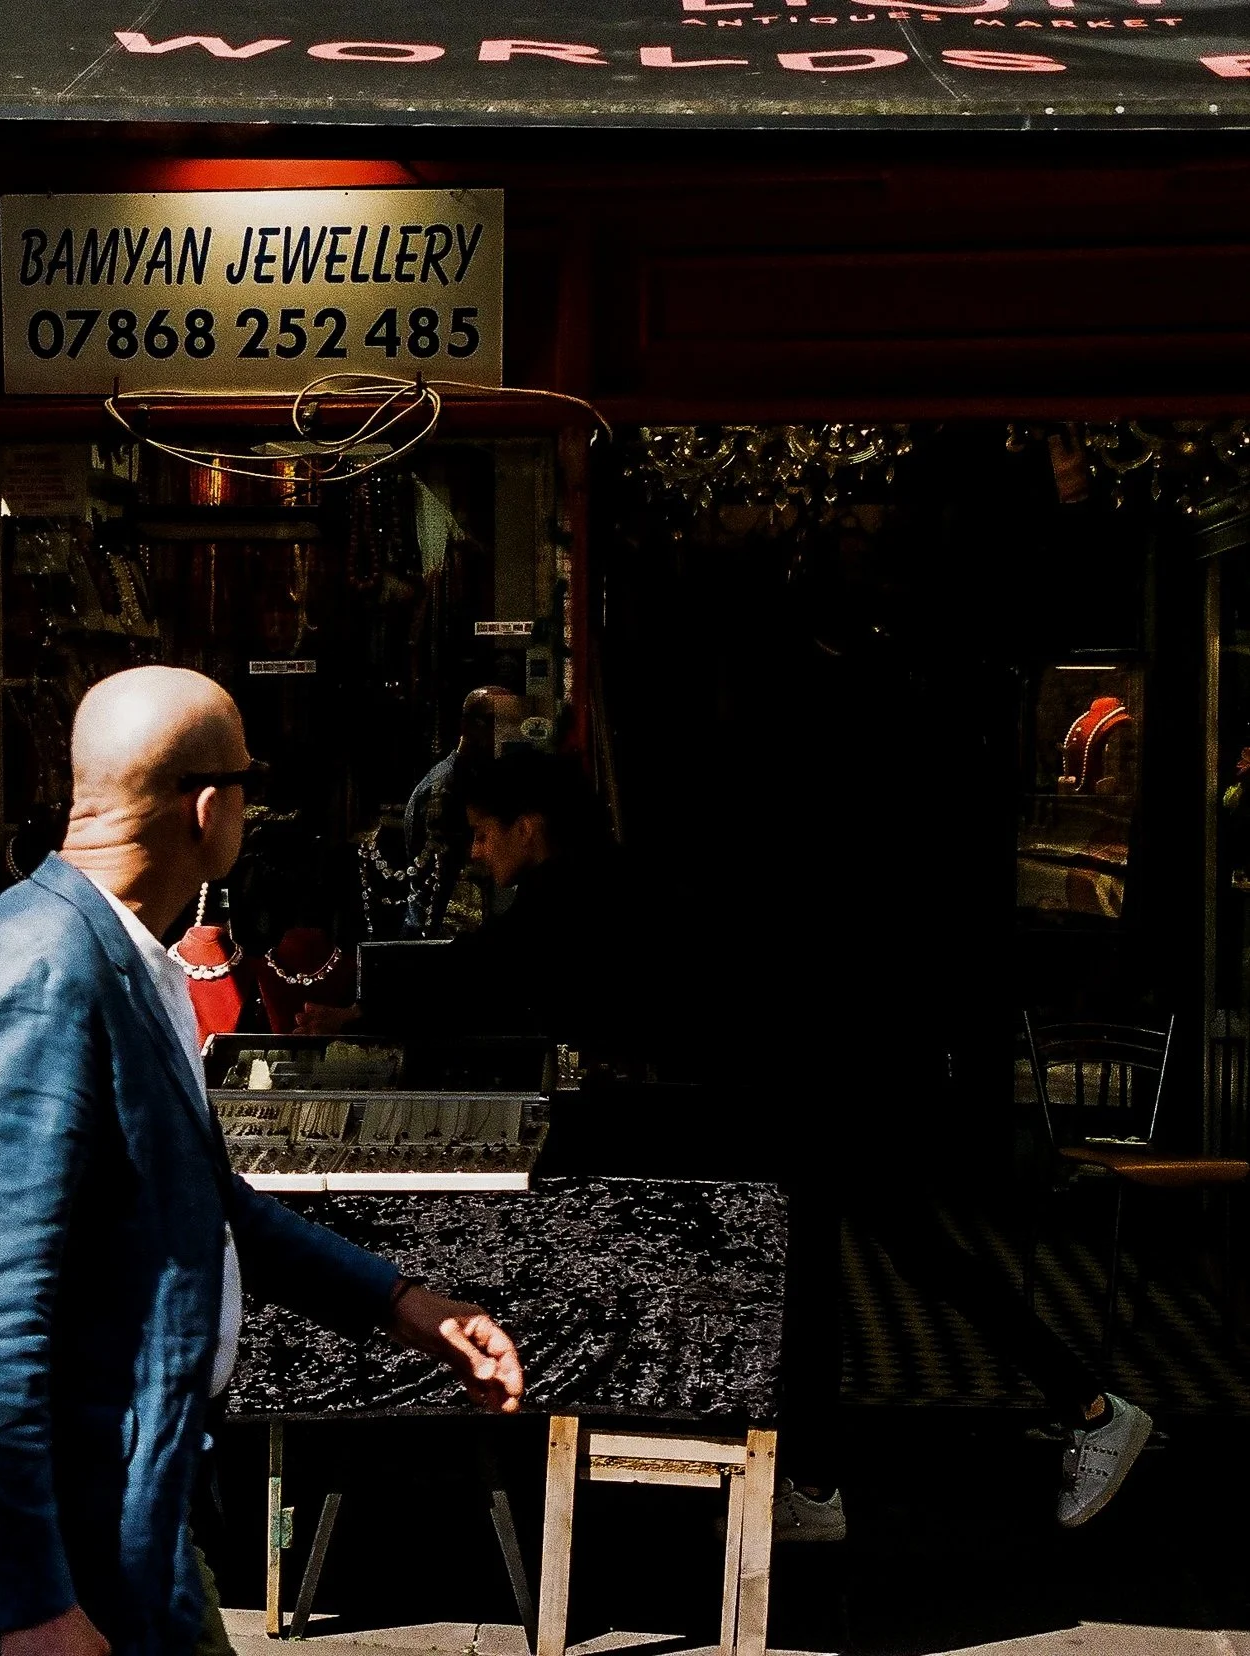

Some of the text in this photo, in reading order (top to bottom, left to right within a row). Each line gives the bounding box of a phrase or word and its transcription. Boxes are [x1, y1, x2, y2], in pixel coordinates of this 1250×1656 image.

[681, 11, 1183, 28] ANTIQUES MARKET
[113, 31, 1068, 73] WORLDS
[19, 222, 484, 288] BAMYAN JEWELLERY
[26, 306, 481, 360] 07868 252 485
